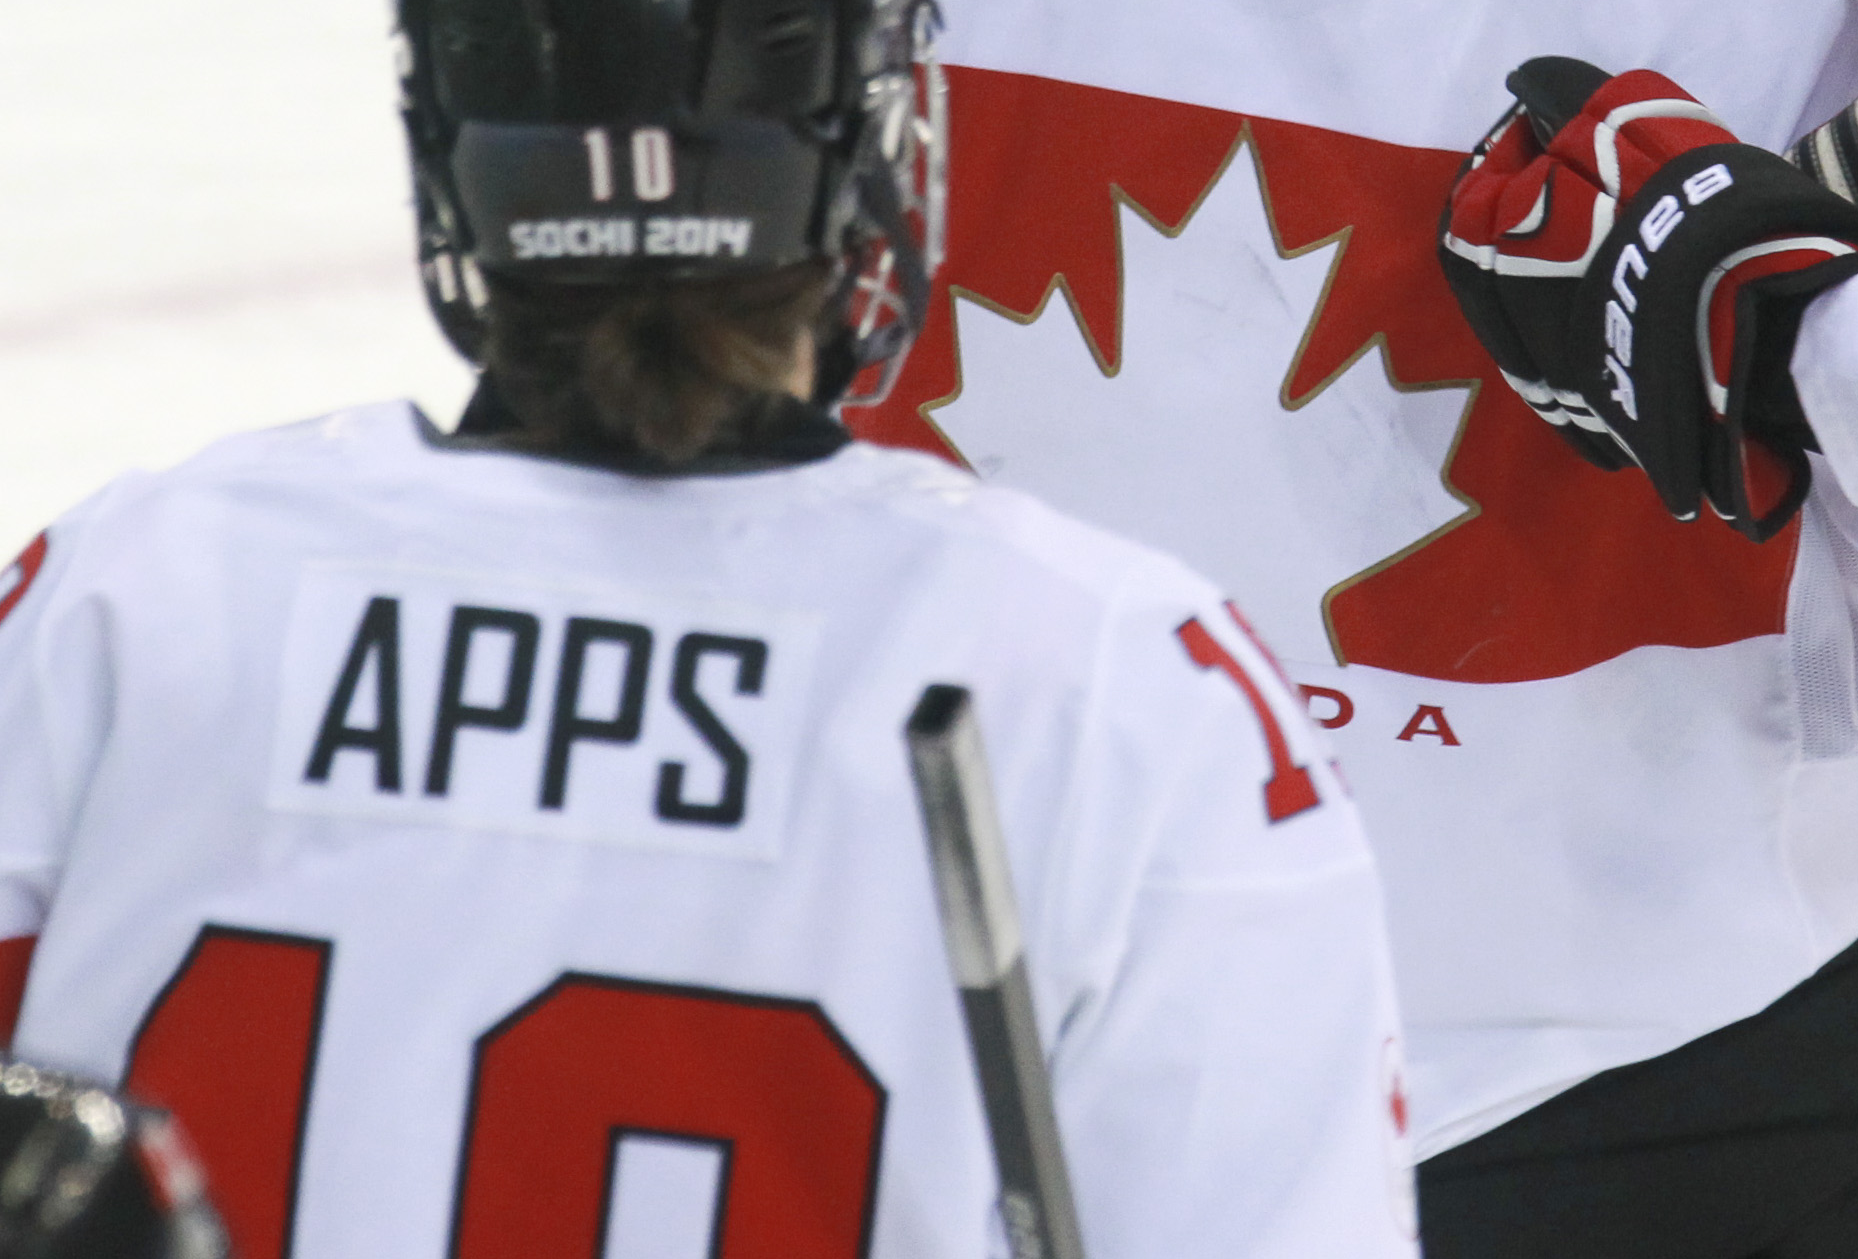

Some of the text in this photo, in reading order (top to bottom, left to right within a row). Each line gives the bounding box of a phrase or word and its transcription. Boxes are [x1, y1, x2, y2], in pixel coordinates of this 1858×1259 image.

[508, 215, 753, 261] SOCHI 2014
[583, 125, 675, 203] 10
[1604, 163, 1735, 422] BAUER
[303, 595, 769, 828] APPS
